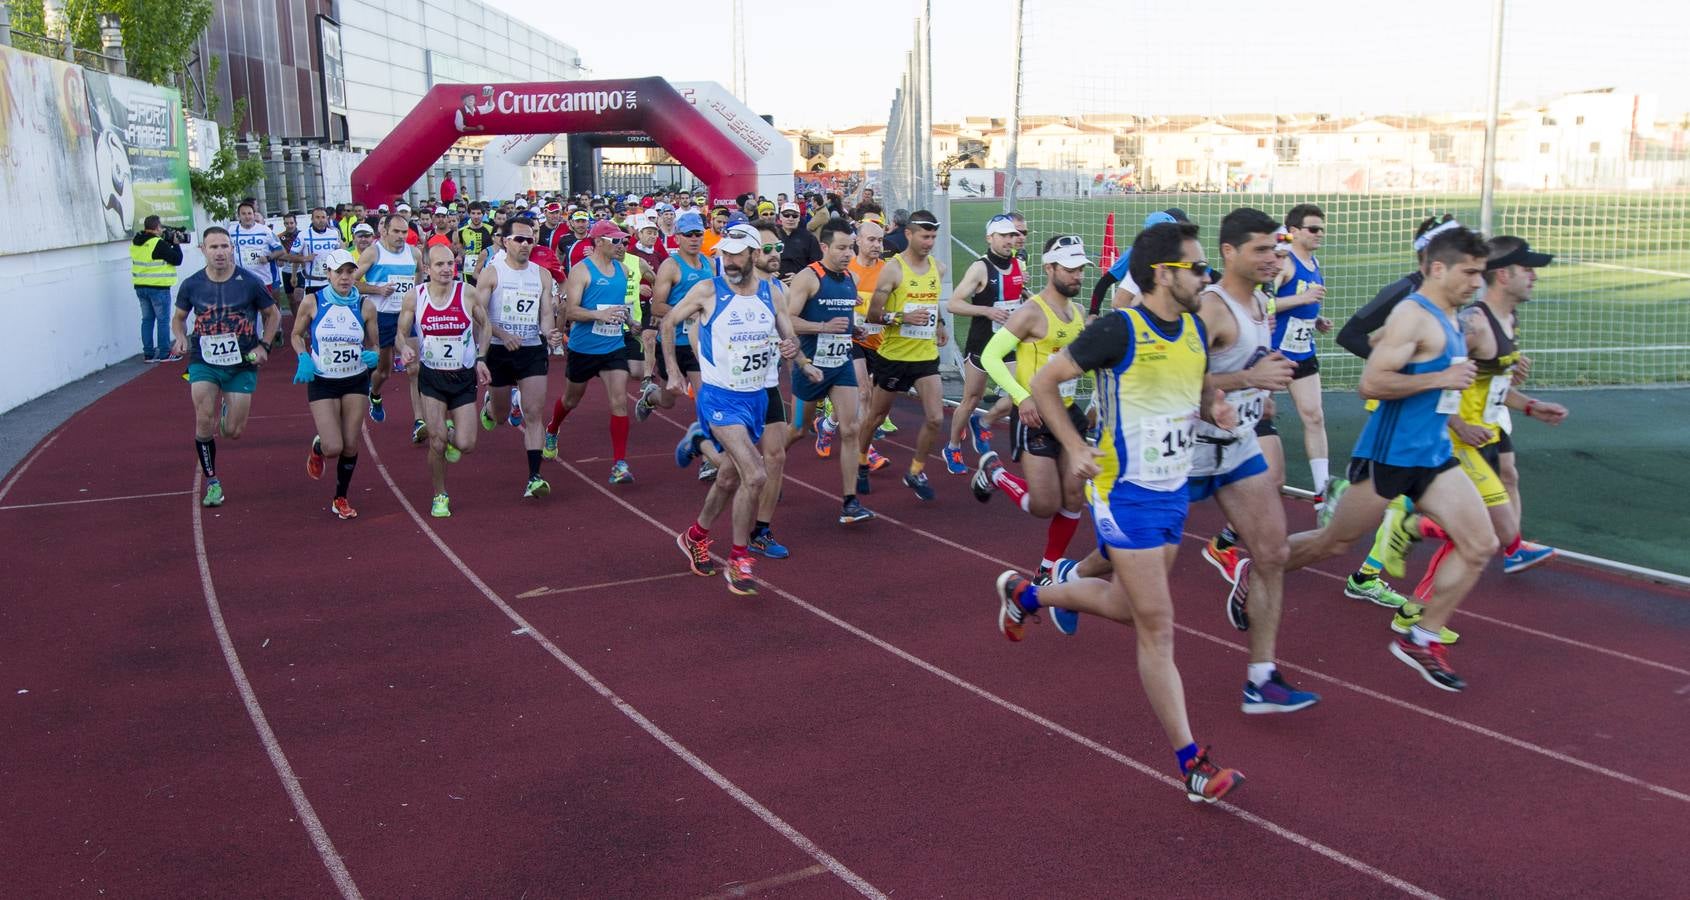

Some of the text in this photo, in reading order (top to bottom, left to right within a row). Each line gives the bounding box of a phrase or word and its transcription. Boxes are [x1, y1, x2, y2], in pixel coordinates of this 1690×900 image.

[498, 90, 637, 114] Cruzcampo SIN
[516, 299, 535, 312] 67
[826, 298, 857, 306] INTERSPO
[210, 340, 238, 356] 212
[443, 344, 453, 358] 2
[333, 349, 359, 364] 254
[742, 351, 769, 372] 255
